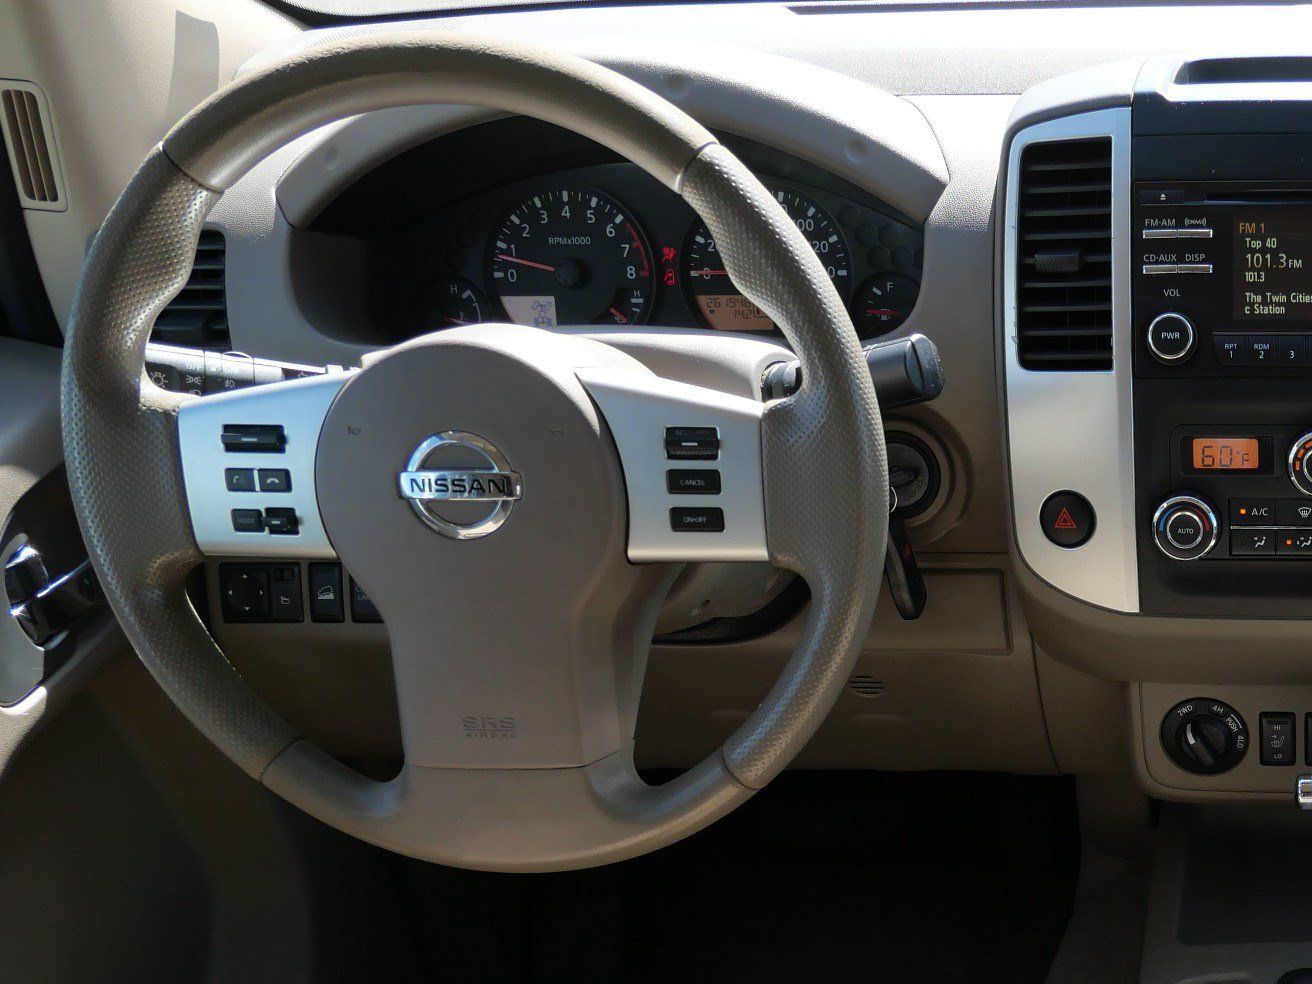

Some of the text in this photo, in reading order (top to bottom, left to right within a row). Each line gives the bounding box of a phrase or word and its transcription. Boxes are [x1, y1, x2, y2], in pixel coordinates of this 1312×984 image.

[540, 211, 548, 223] 3
[561, 205, 571, 218] 4
[587, 211, 595, 223] 5
[521, 224, 530, 237] 2
[606, 224, 616, 237] 6
[1239, 223, 1265, 234] FM 1
[548, 236, 591, 245] RPMx1000
[1245, 238, 1277, 249] Top 40
[511, 244, 516, 257] 1
[621, 245, 630, 257] 7
[1185, 254, 1206, 262] DISP
[1245, 253, 1302, 269] 101.3 FM
[507, 269, 517, 282] 0
[626, 266, 636, 279] 8
[1244, 272, 1265, 282] 101.3
[450, 285, 458, 294] H
[886, 282, 894, 292] F
[1163, 289, 1181, 297] VOL
[1245, 293, 1262, 303] The
[1266, 293, 1287, 303] Twin
[1244, 304, 1285, 314] c Station
[1161, 332, 1180, 340] PWR
[1259, 351, 1265, 359] 2
[1289, 351, 1295, 359] 3
[410, 478, 506, 494] NISSAN
[1251, 507, 1269, 516] A/C
[1177, 704, 1193, 717] 2WD
[1212, 705, 1224, 714] 4H
[462, 715, 516, 729] SRS
[1225, 717, 1238, 733] PUSH
[1236, 735, 1244, 749] 4LO
